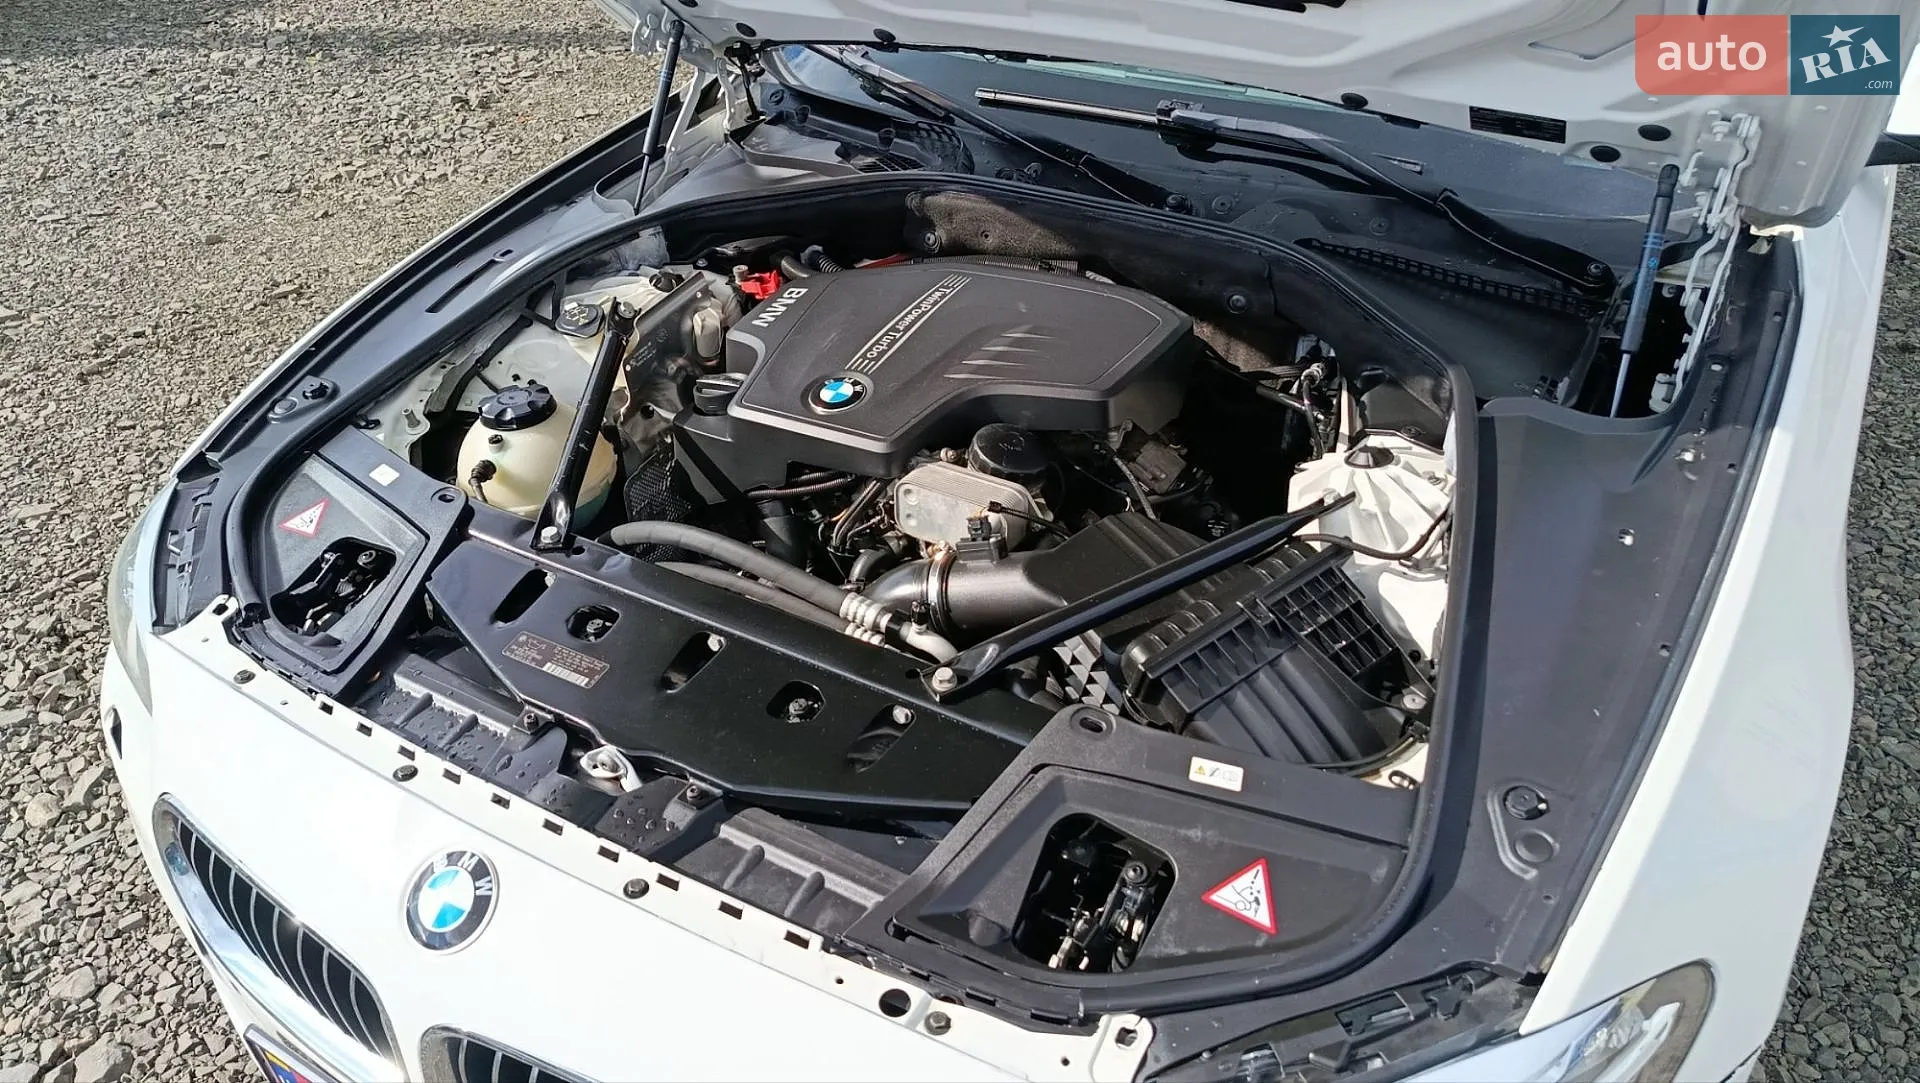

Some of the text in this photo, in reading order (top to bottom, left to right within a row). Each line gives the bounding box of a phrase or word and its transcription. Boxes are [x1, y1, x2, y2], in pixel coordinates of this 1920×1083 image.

[752, 287, 808, 328] BMW
[866, 287, 954, 358] TwinPower Turbo
